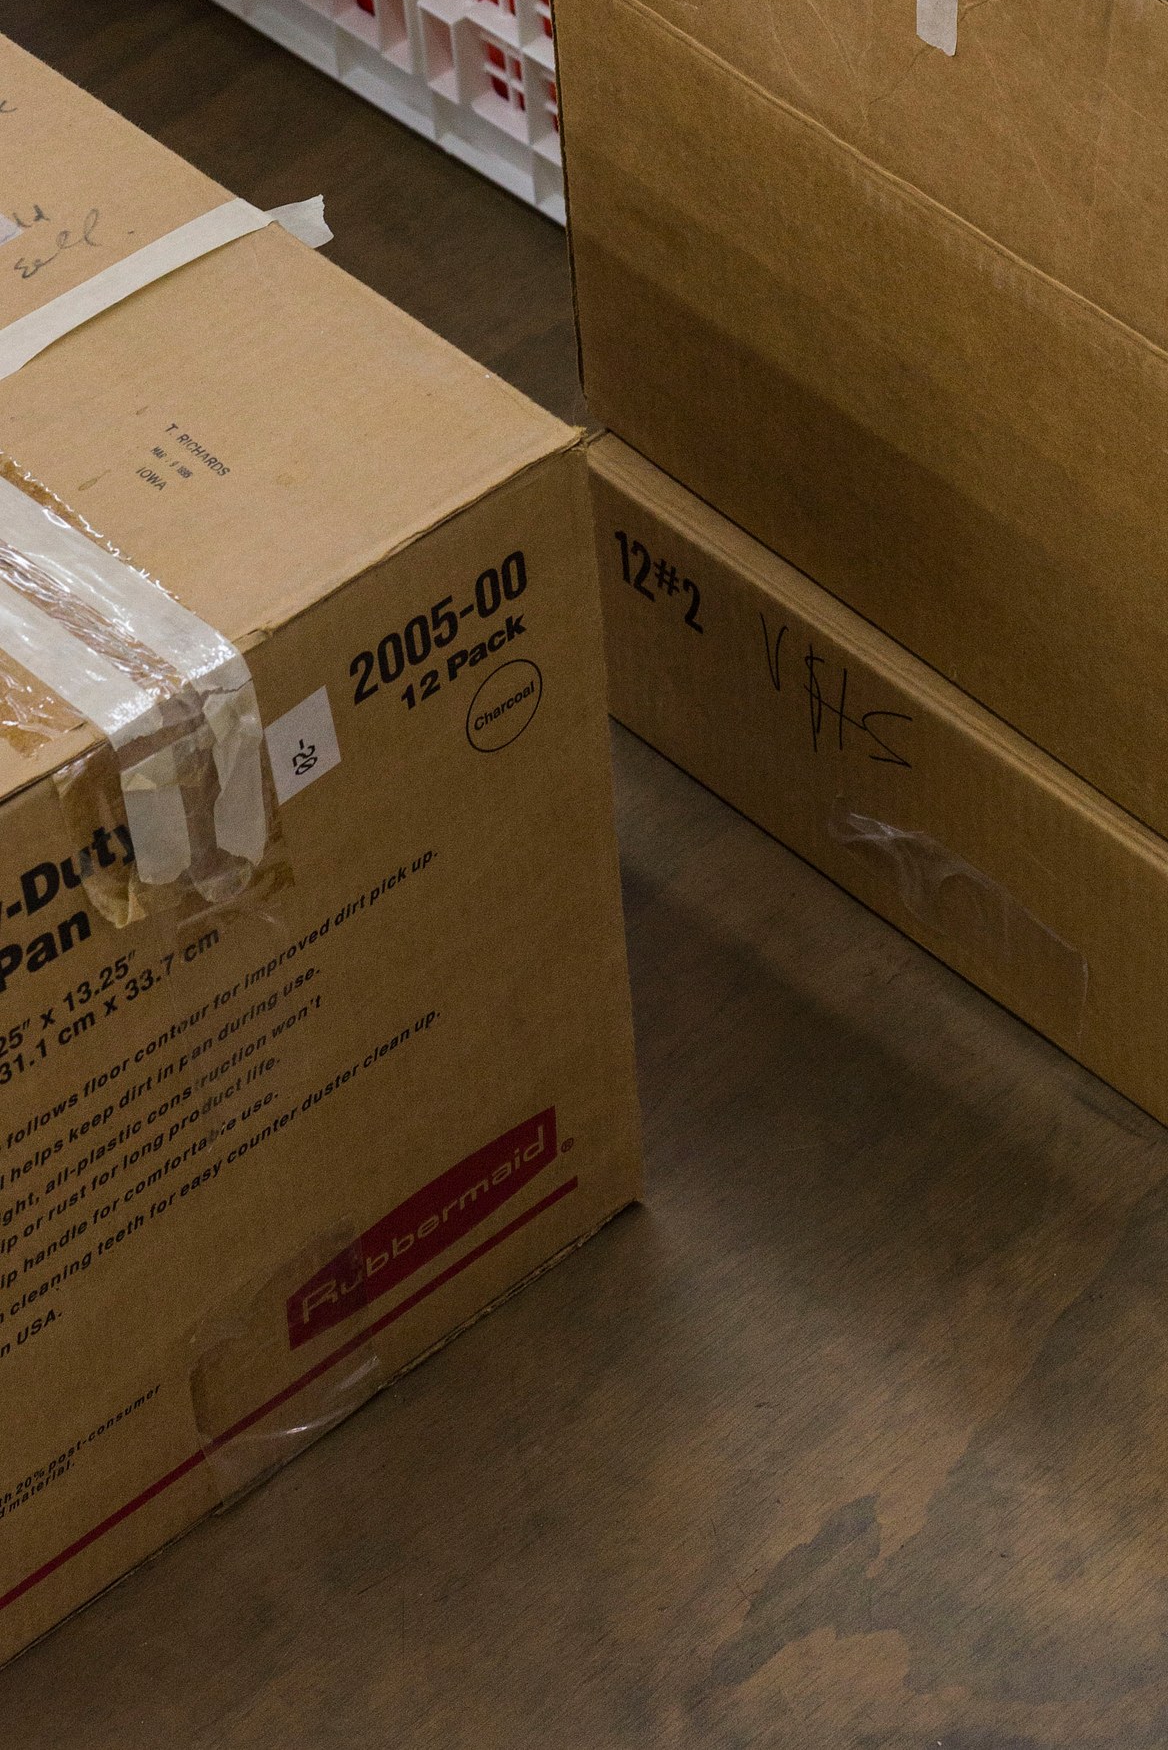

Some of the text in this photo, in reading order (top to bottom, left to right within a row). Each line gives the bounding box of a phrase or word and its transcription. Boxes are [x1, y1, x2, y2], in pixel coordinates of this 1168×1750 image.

[135, 466, 168, 491] IOWA
[176, 433, 231, 477] RICHARDS
[350, 550, 528, 706] 2005-00
[614, 529, 703, 634] 12#2
[400, 614, 527, 711] 12 Pack
[474, 680, 535, 731] Charcoal
[0, 949, 137, 1058] 25" x 13.25"
[6, 849, 439, 1149] follows floor contour for improved dirt pick up.
[57, 1008, 97, 1046] cm
[103, 994, 119, 1018] x
[124, 953, 176, 1002] 33.7
[184, 928, 220, 963] cm
[10, 966, 321, 1183] helps keep dirt in pan during use.
[45, 1120, 143, 1196] all-plastic
[271, 994, 322, 1039] won't
[9, 1008, 442, 1317] cleaning teeth for easy counter duster clean up.
[23, 1215, 44, 1238] or
[48, 1184, 88, 1222] rust
[91, 1163, 120, 1192] for
[122, 1132, 166, 1171] long
[168, 1078, 243, 1143] product
[246, 1056, 282, 1086] life.
[23, 1220, 89, 1274] handle
[92, 1197, 121, 1226] for
[241, 1091, 280, 1122] use.
[300, 1123, 548, 1327] Rubbermaid
[16, 1307, 63, 1346] USA.
[8, 1460, 76, 1516] material.
[15, 1466, 46, 1496] 20%
[48, 1383, 162, 1477] post-consumer
